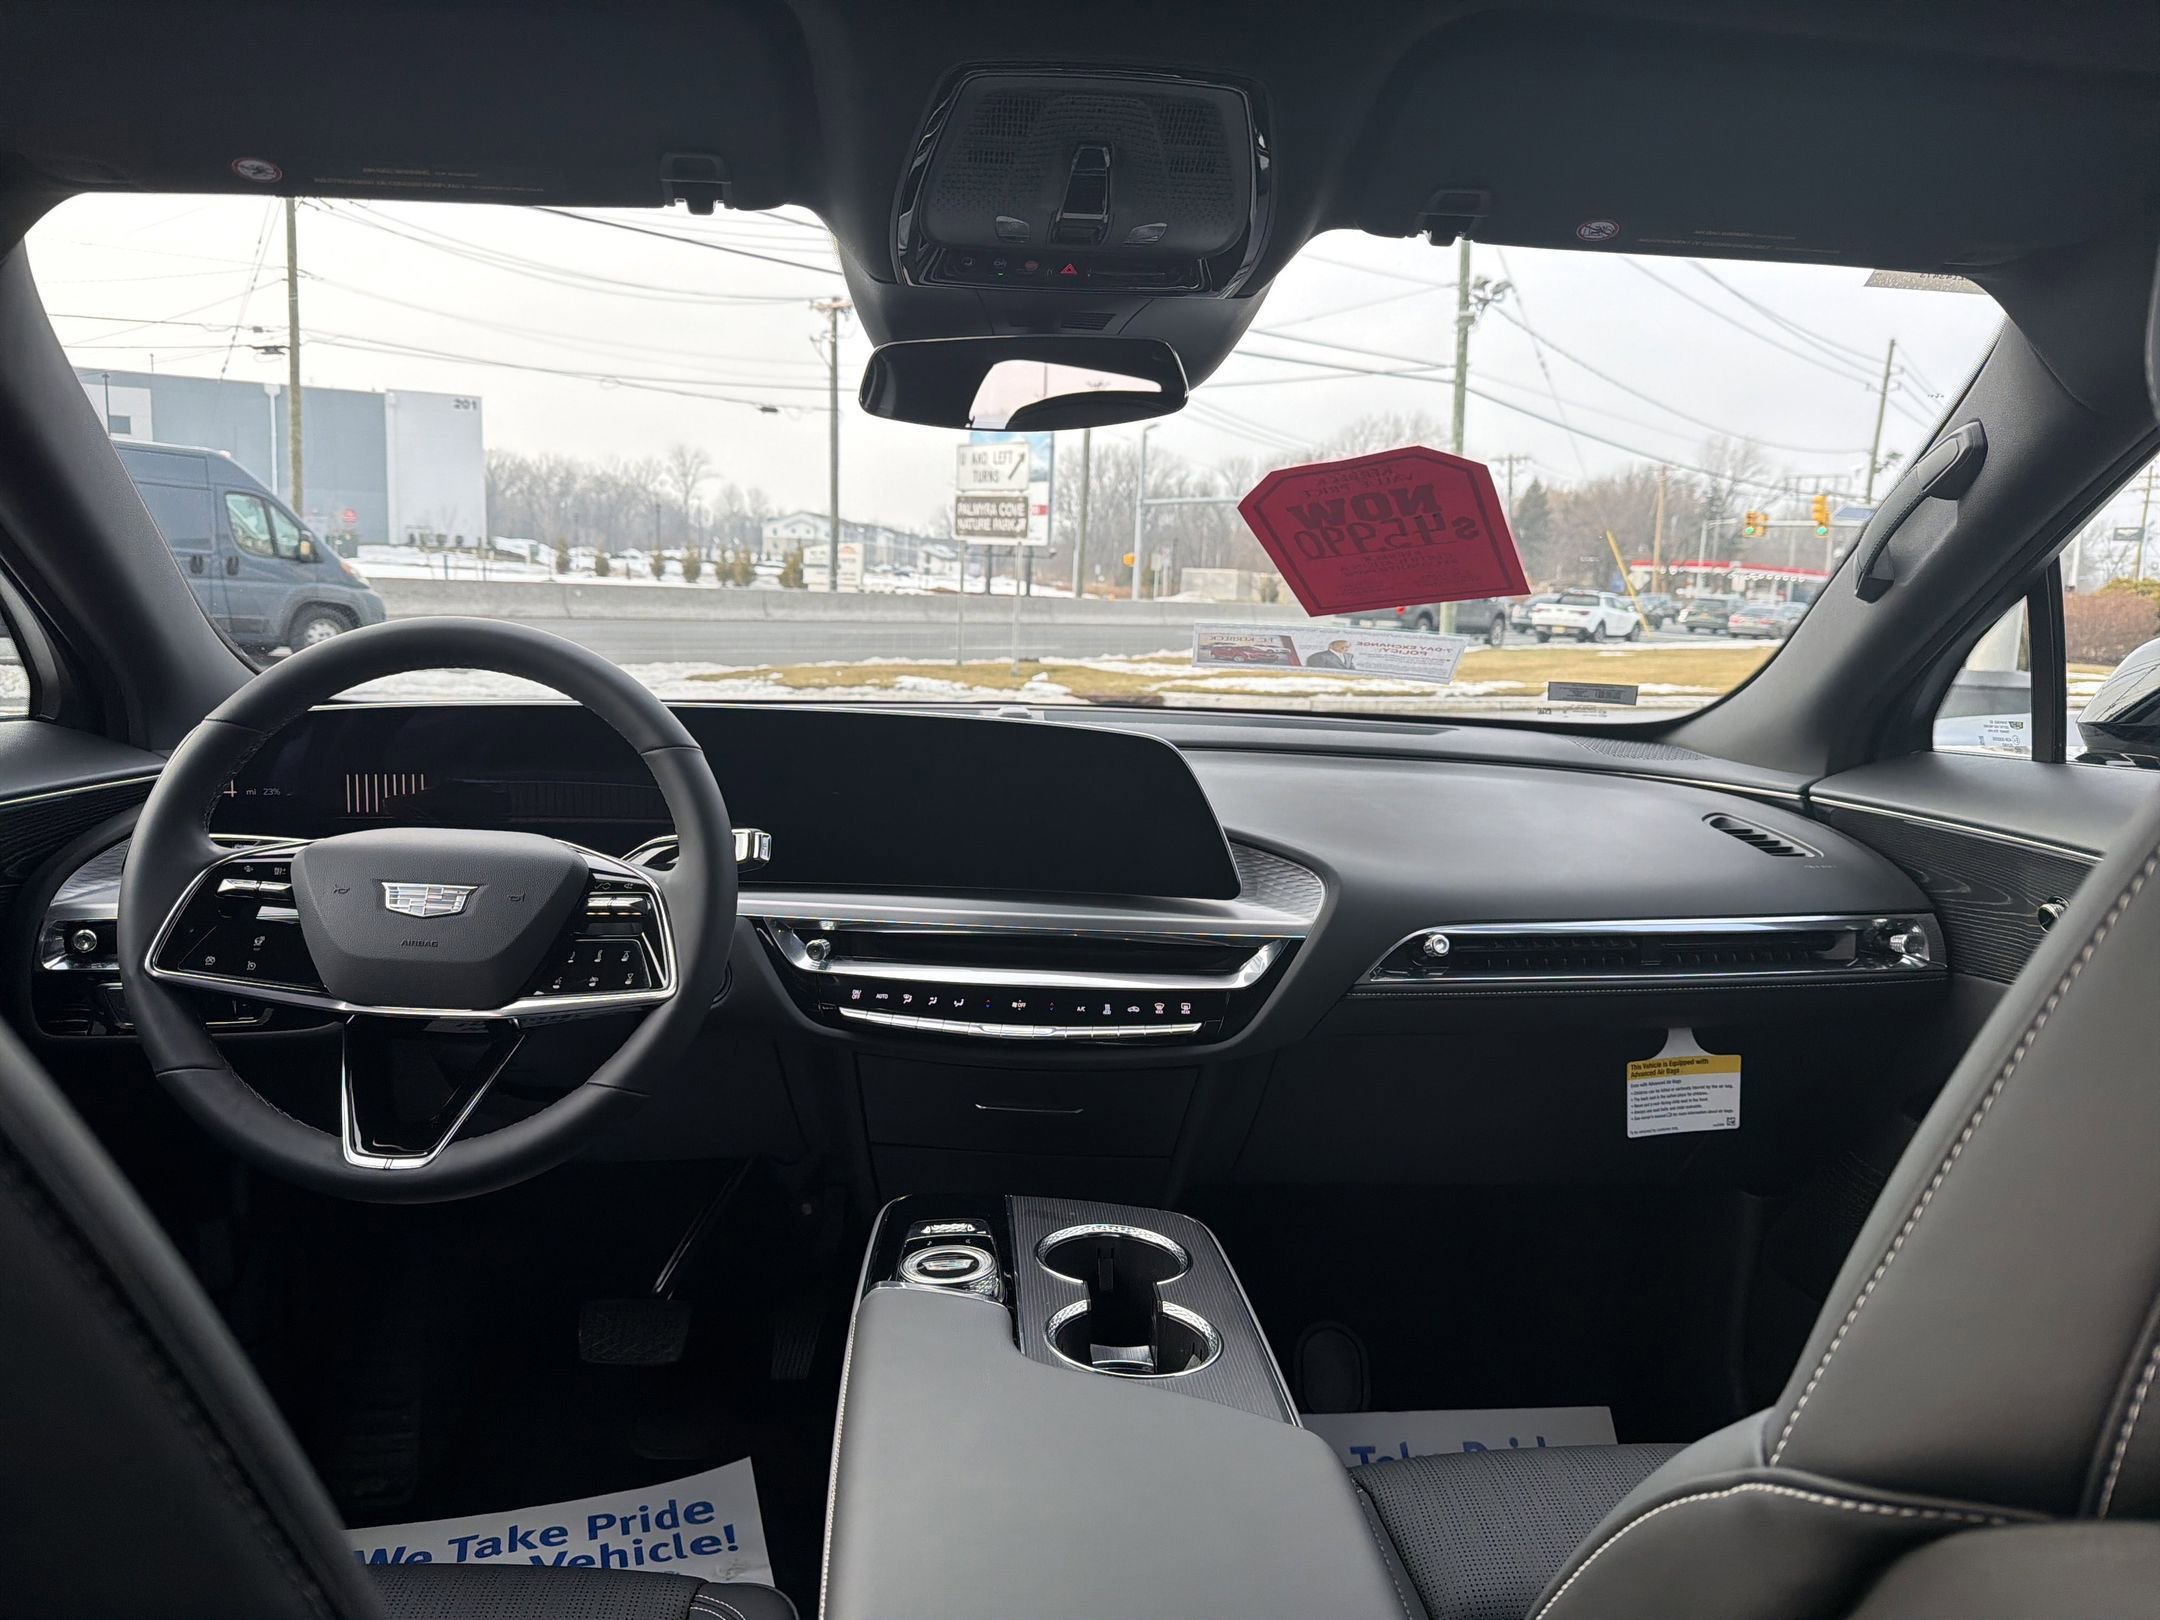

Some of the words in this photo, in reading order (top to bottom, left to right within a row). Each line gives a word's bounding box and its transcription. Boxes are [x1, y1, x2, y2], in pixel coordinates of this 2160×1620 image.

[453, 398, 477, 410] 201
[993, 450, 1013, 466] LEFT
[973, 470, 999, 483] TURNS
[998, 502, 1025, 517] COVE
[246, 788, 257, 796] mi
[263, 788, 281, 796] 23%
[401, 939, 439, 948] AIRBAG
[1630, 1063, 1642, 1071] This
[1642, 1062, 1662, 1070] Vehicle
[1669, 1060, 1695, 1068] Equipped
[1630, 1069, 1657, 1078] Advanced
[1657, 1068, 1666, 1076] Air
[1666, 1068, 1680, 1076] Bags
[354, 1546, 433, 1566] We
[447, 1524, 569, 1563] Take
[587, 1499, 714, 1541] Pride
[529, 1523, 740, 1569] Vehicle!
